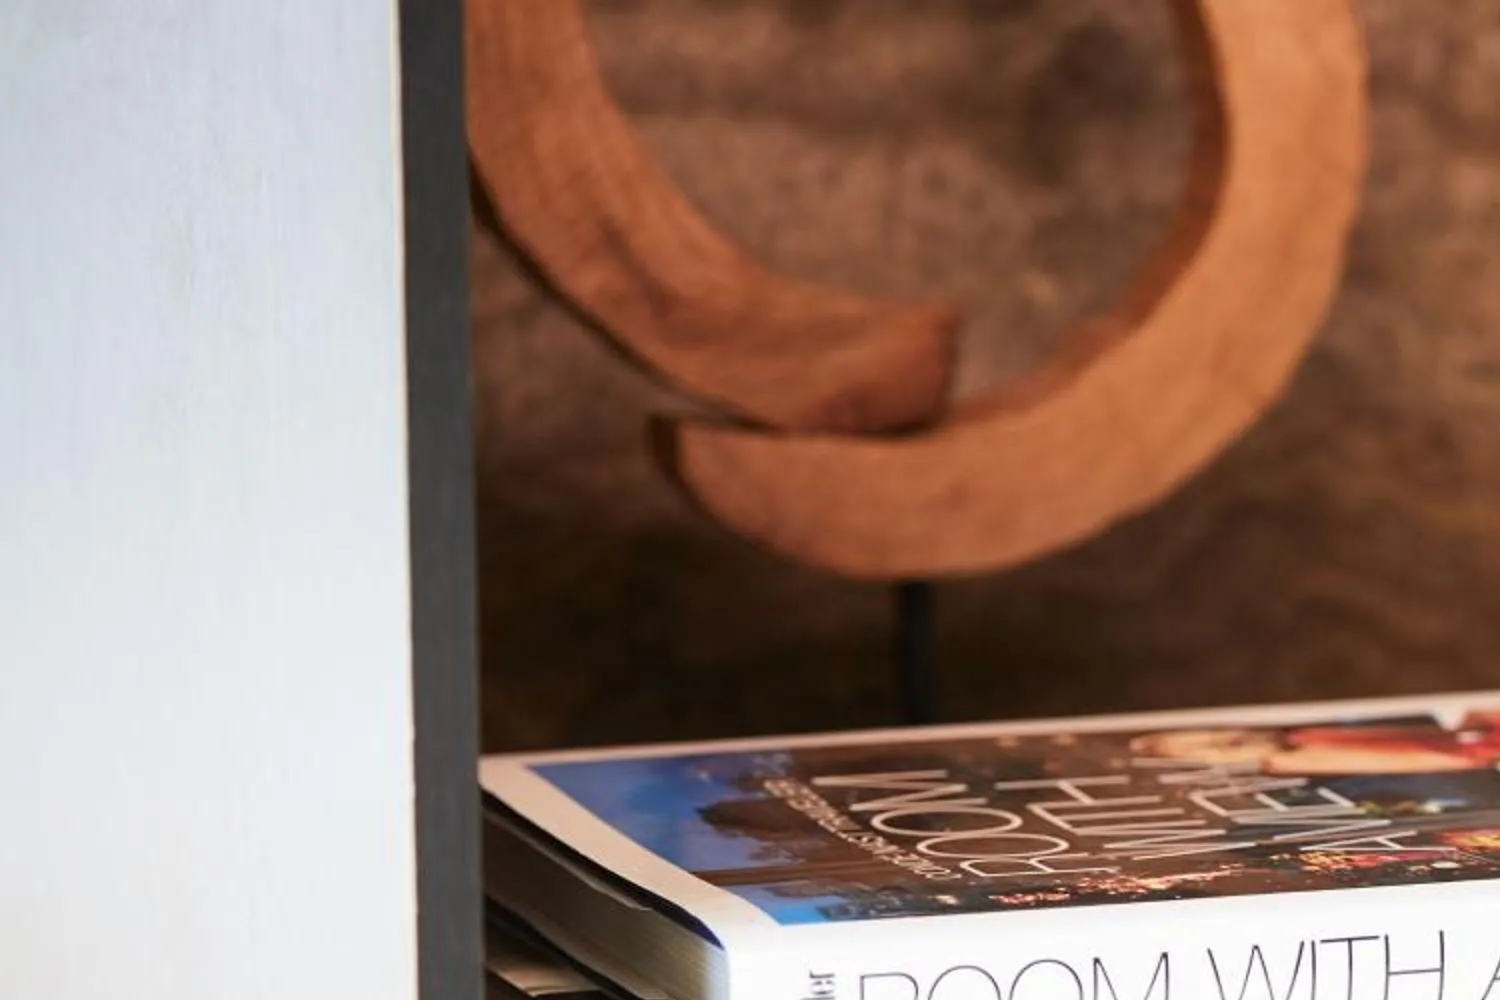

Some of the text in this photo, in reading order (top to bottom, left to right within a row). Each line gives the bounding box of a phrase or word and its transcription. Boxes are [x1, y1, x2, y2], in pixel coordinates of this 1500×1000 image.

[810, 768, 1118, 877] ROOM
[994, 774, 1256, 861] WITH
[1130, 757, 1457, 852] A VIEW
